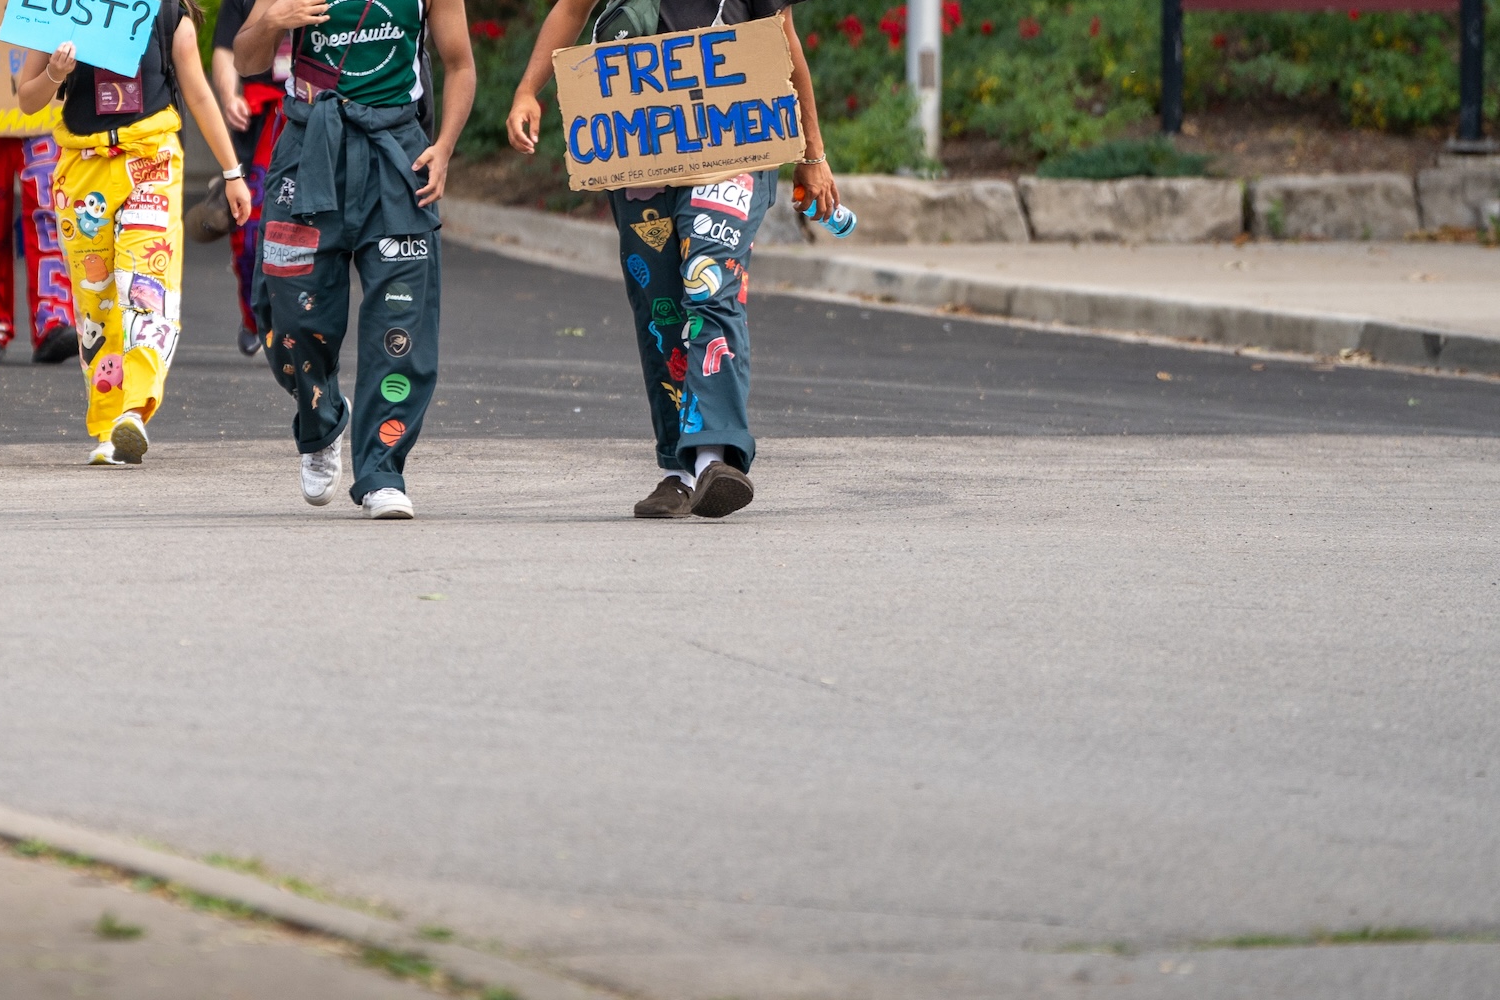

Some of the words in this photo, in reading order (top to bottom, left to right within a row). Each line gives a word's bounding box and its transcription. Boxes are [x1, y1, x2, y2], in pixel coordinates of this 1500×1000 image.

[310, 21, 405, 53] Greensuits
[593, 29, 746, 98] FREE
[611, 172, 626, 183] ONE
[628, 168, 644, 181] PER
[689, 163, 700, 171] NO
[131, 194, 161, 205] HELLO
[696, 183, 749, 209] JACK
[400, 235, 428, 257] dcs
